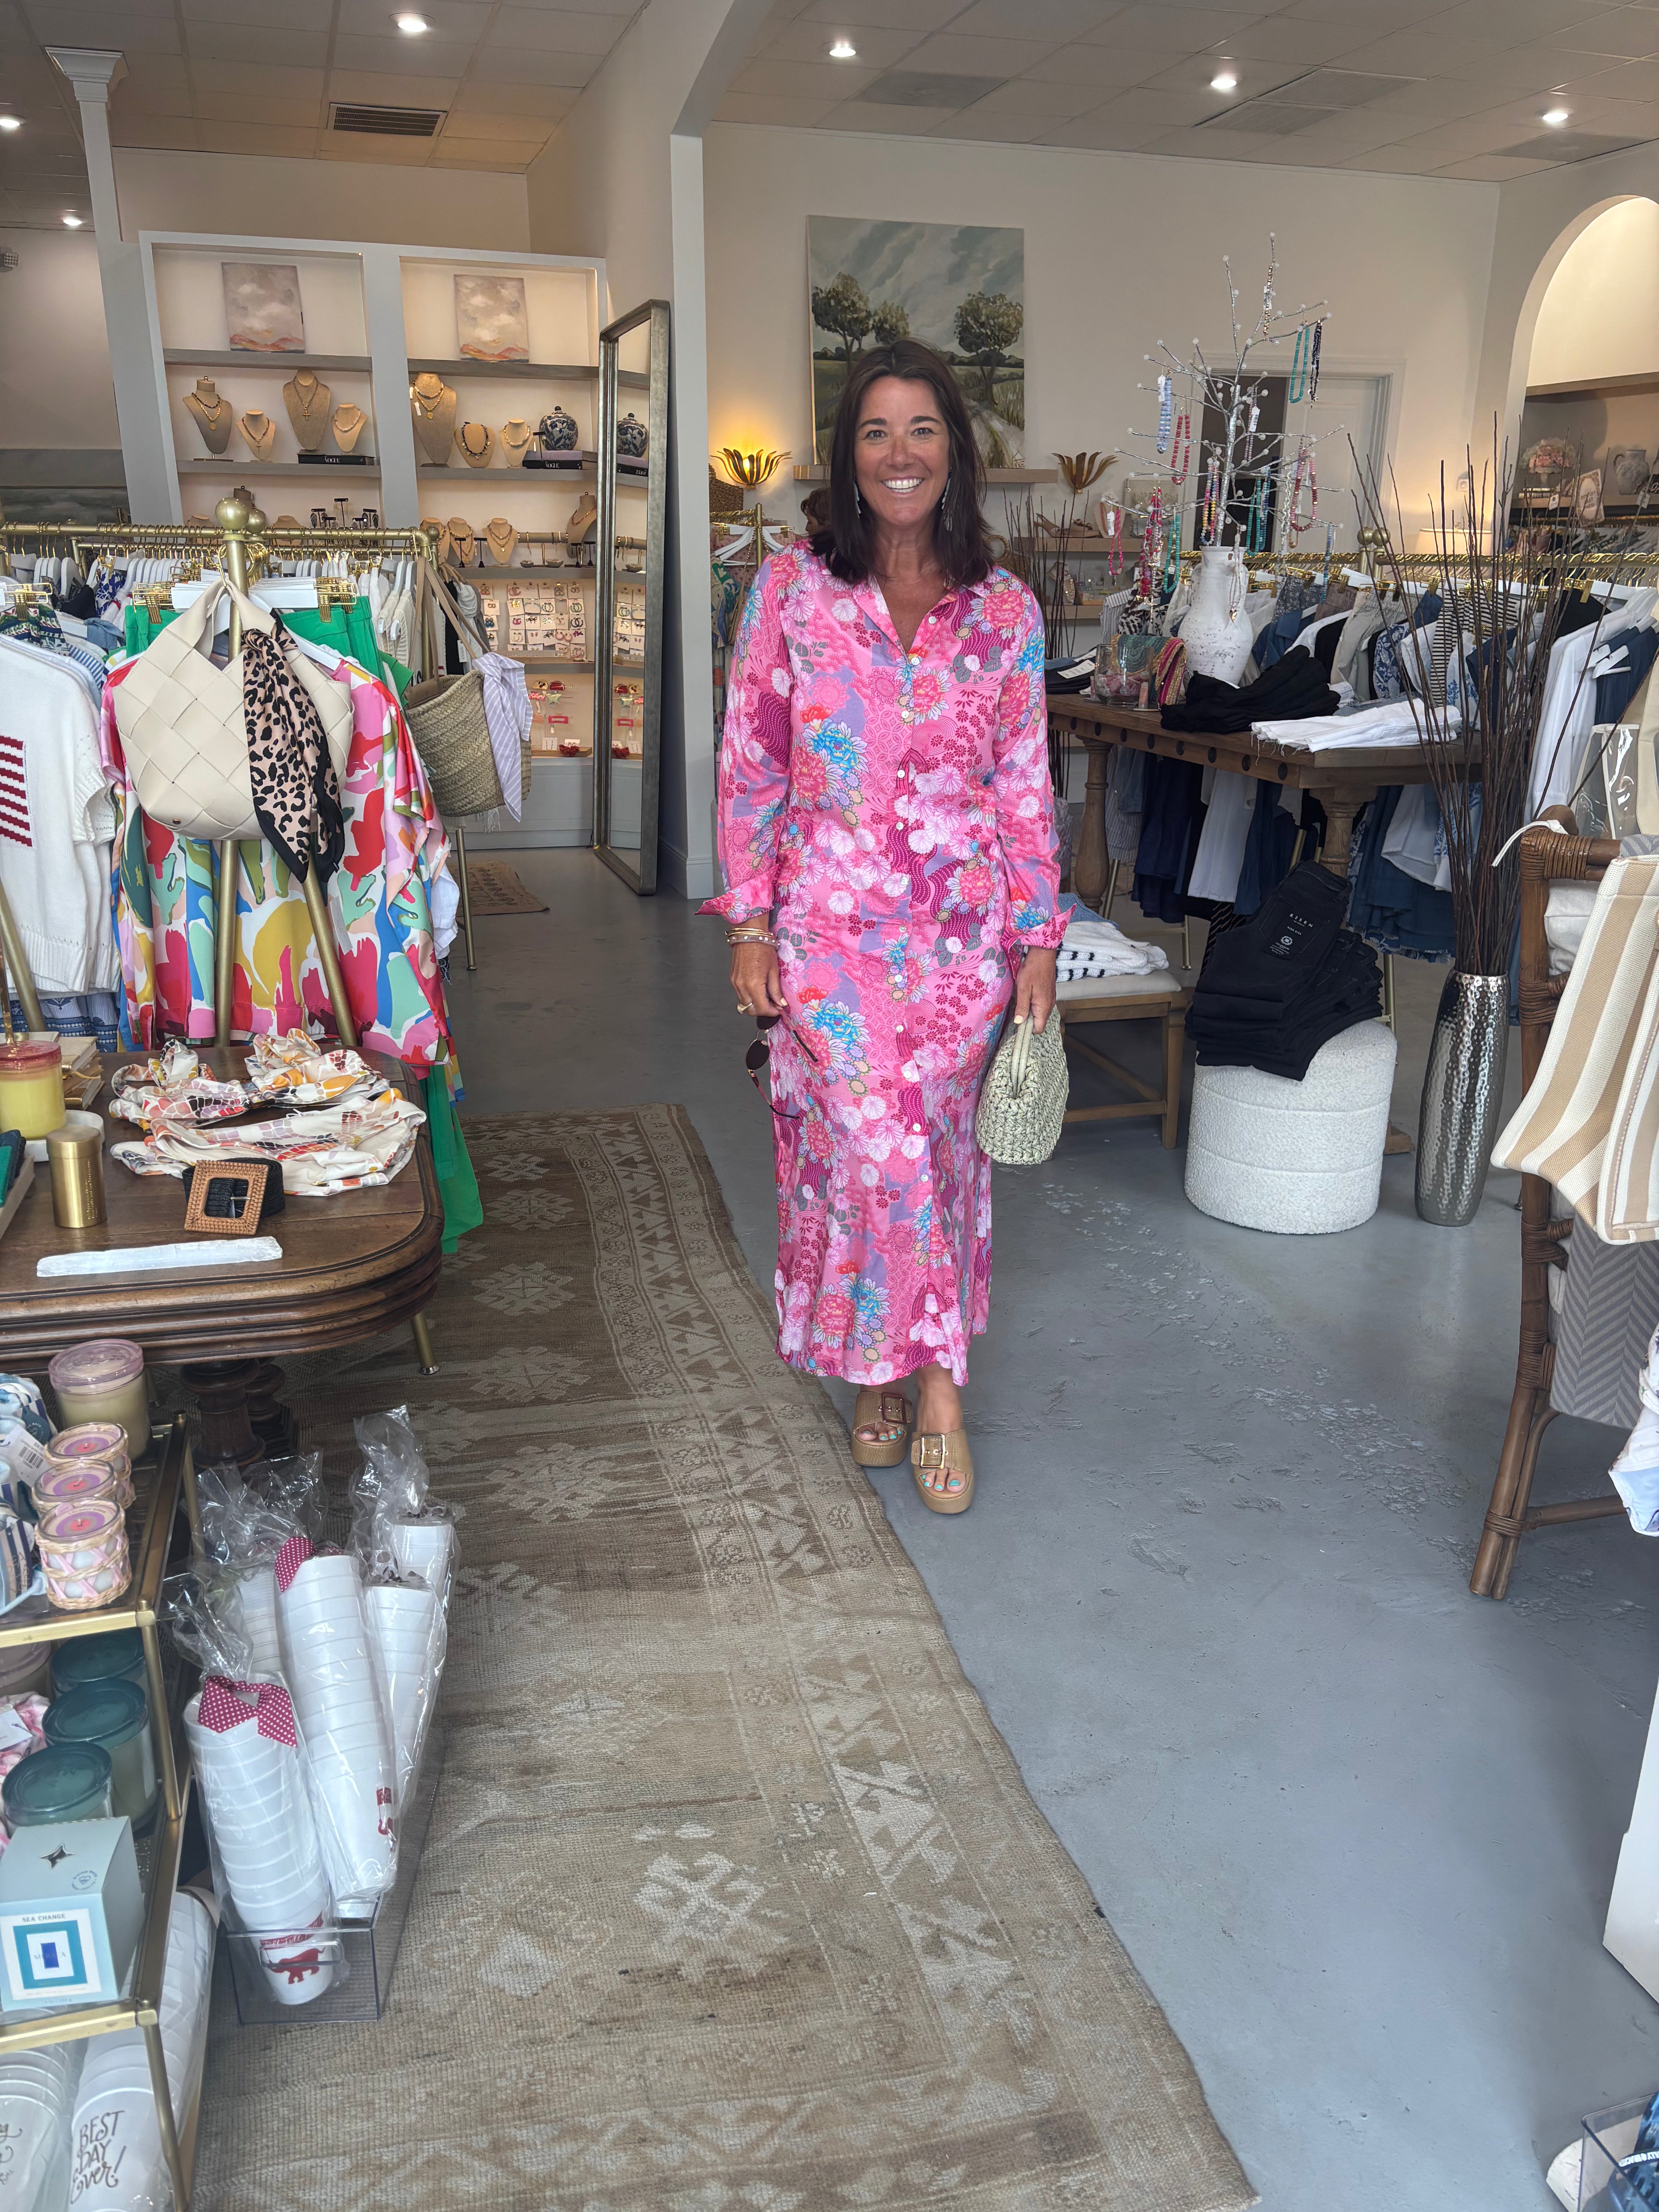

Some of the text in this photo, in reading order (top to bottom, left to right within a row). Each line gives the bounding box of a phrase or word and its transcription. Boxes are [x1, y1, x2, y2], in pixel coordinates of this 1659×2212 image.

[324, 455, 341, 464] VOGUE
[1289, 913, 1313, 927] RISEN
[79, 2110, 125, 2148] BEST
[77, 2138, 112, 2175] DAY
